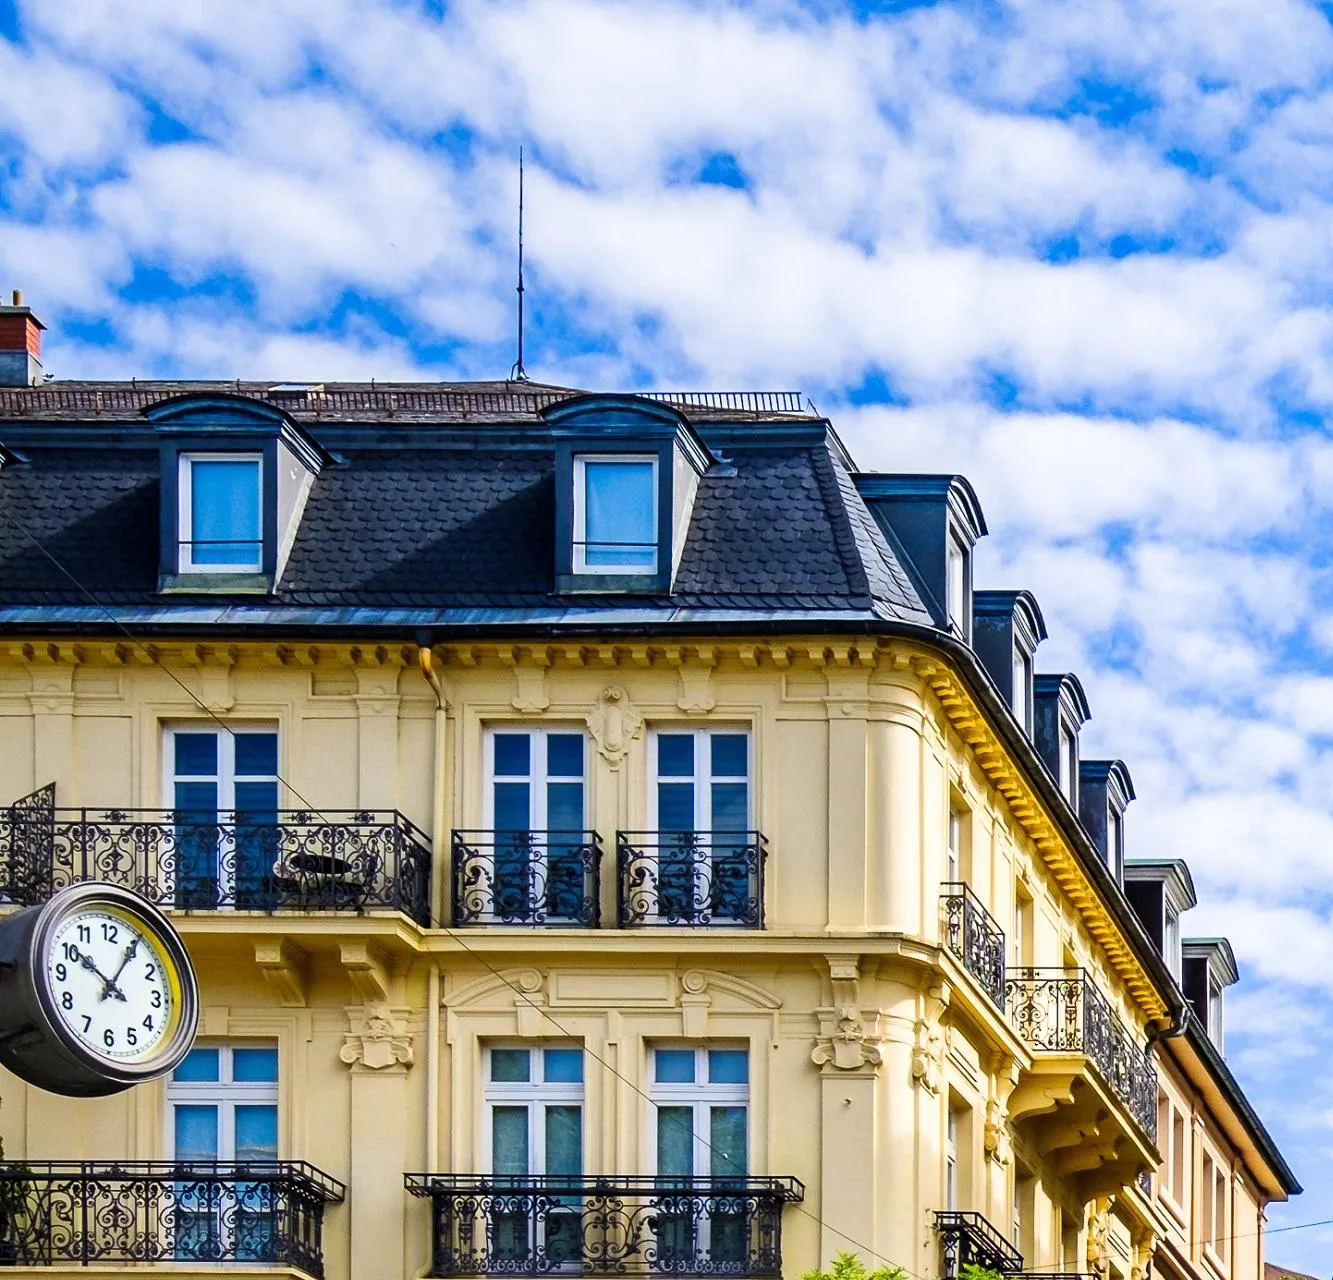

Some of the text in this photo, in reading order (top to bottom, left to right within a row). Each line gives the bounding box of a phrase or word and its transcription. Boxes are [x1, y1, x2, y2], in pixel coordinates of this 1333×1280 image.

[77, 925, 91, 943] 11
[101, 923, 118, 944] 12
[62, 943, 80, 962] 10
[56, 963, 67, 981] 9
[145, 963, 155, 982] 2
[62, 991, 73, 1010] 8
[151, 990, 161, 1008] 3
[81, 1015, 92, 1033] 7
[142, 1015, 154, 1031] 4
[104, 1029, 115, 1047] 6
[127, 1027, 137, 1045] 5
